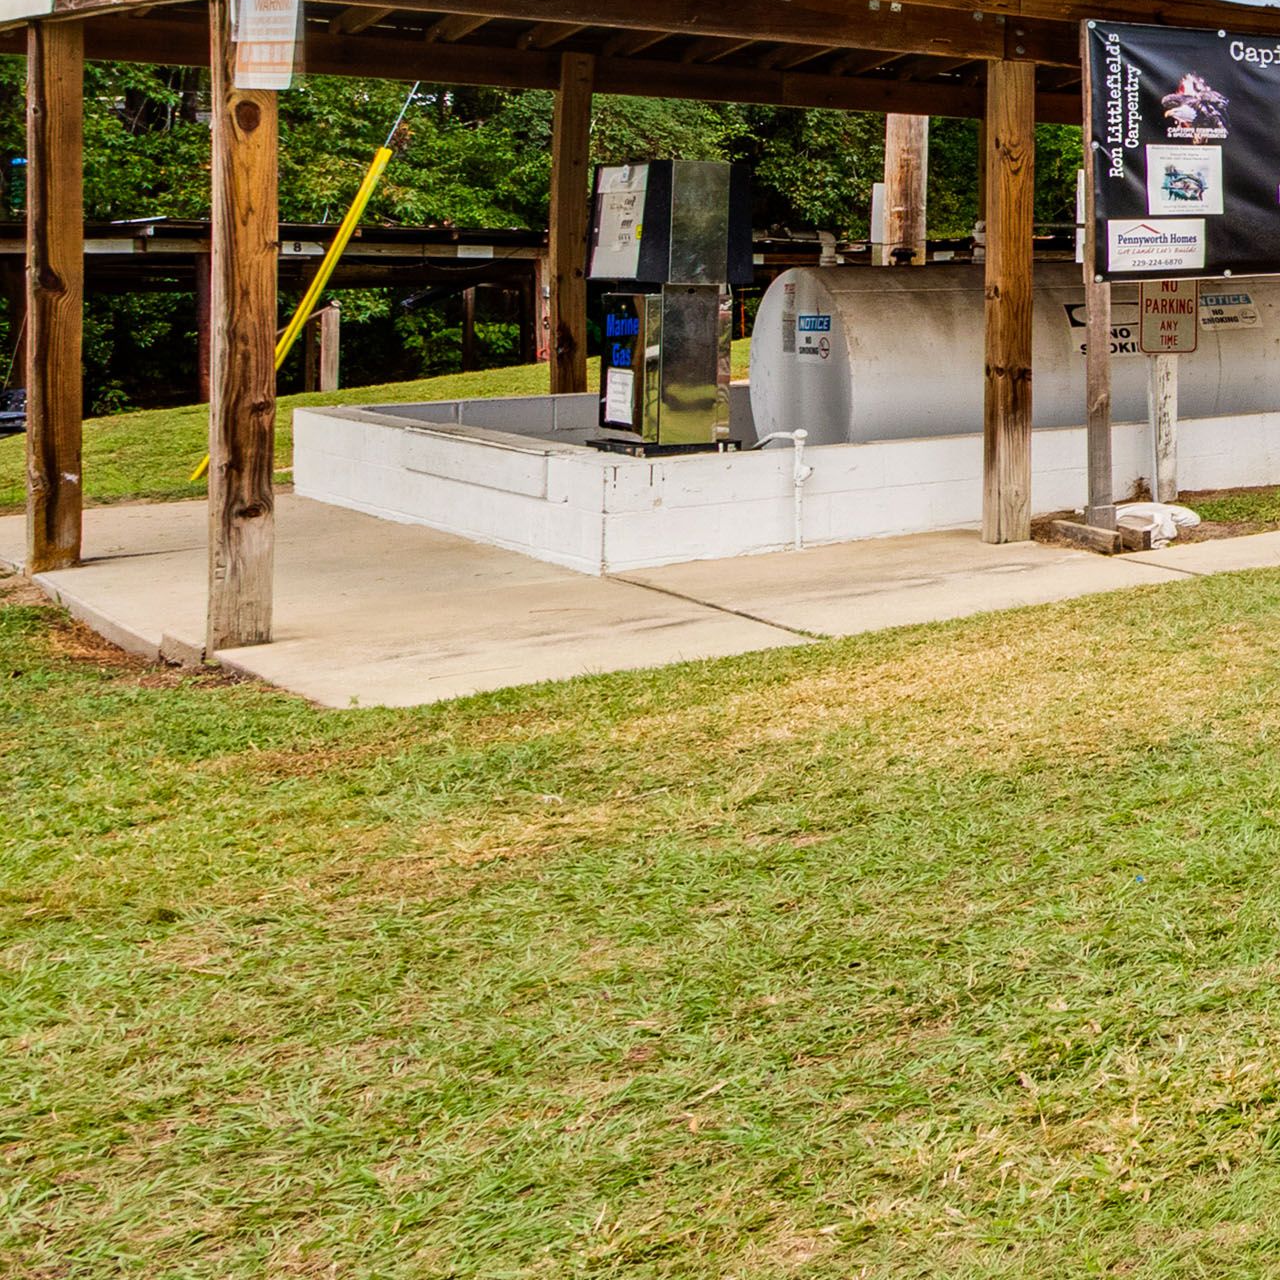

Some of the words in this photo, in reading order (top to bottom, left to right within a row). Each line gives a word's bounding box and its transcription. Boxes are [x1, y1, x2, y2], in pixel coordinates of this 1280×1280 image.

[1106, 33, 1123, 144] Littlefield's
[1124, 64, 1142, 149] Carpentry
[1109, 147, 1124, 179] Ron
[1117, 233, 1168, 247] Pennyworth
[1170, 233, 1197, 244] Homes
[293, 241, 302, 253] 8
[1145, 298, 1194, 314] PARKING
[1200, 295, 1248, 305] NOTICE
[1212, 308, 1224, 316] NO
[606, 313, 639, 337] Marine
[800, 317, 830, 330] NOTICE
[1160, 321, 1178, 331] ANY
[1202, 316, 1239, 325] SMOKING
[1160, 335, 1178, 346] TIME
[612, 343, 631, 367] Gas
